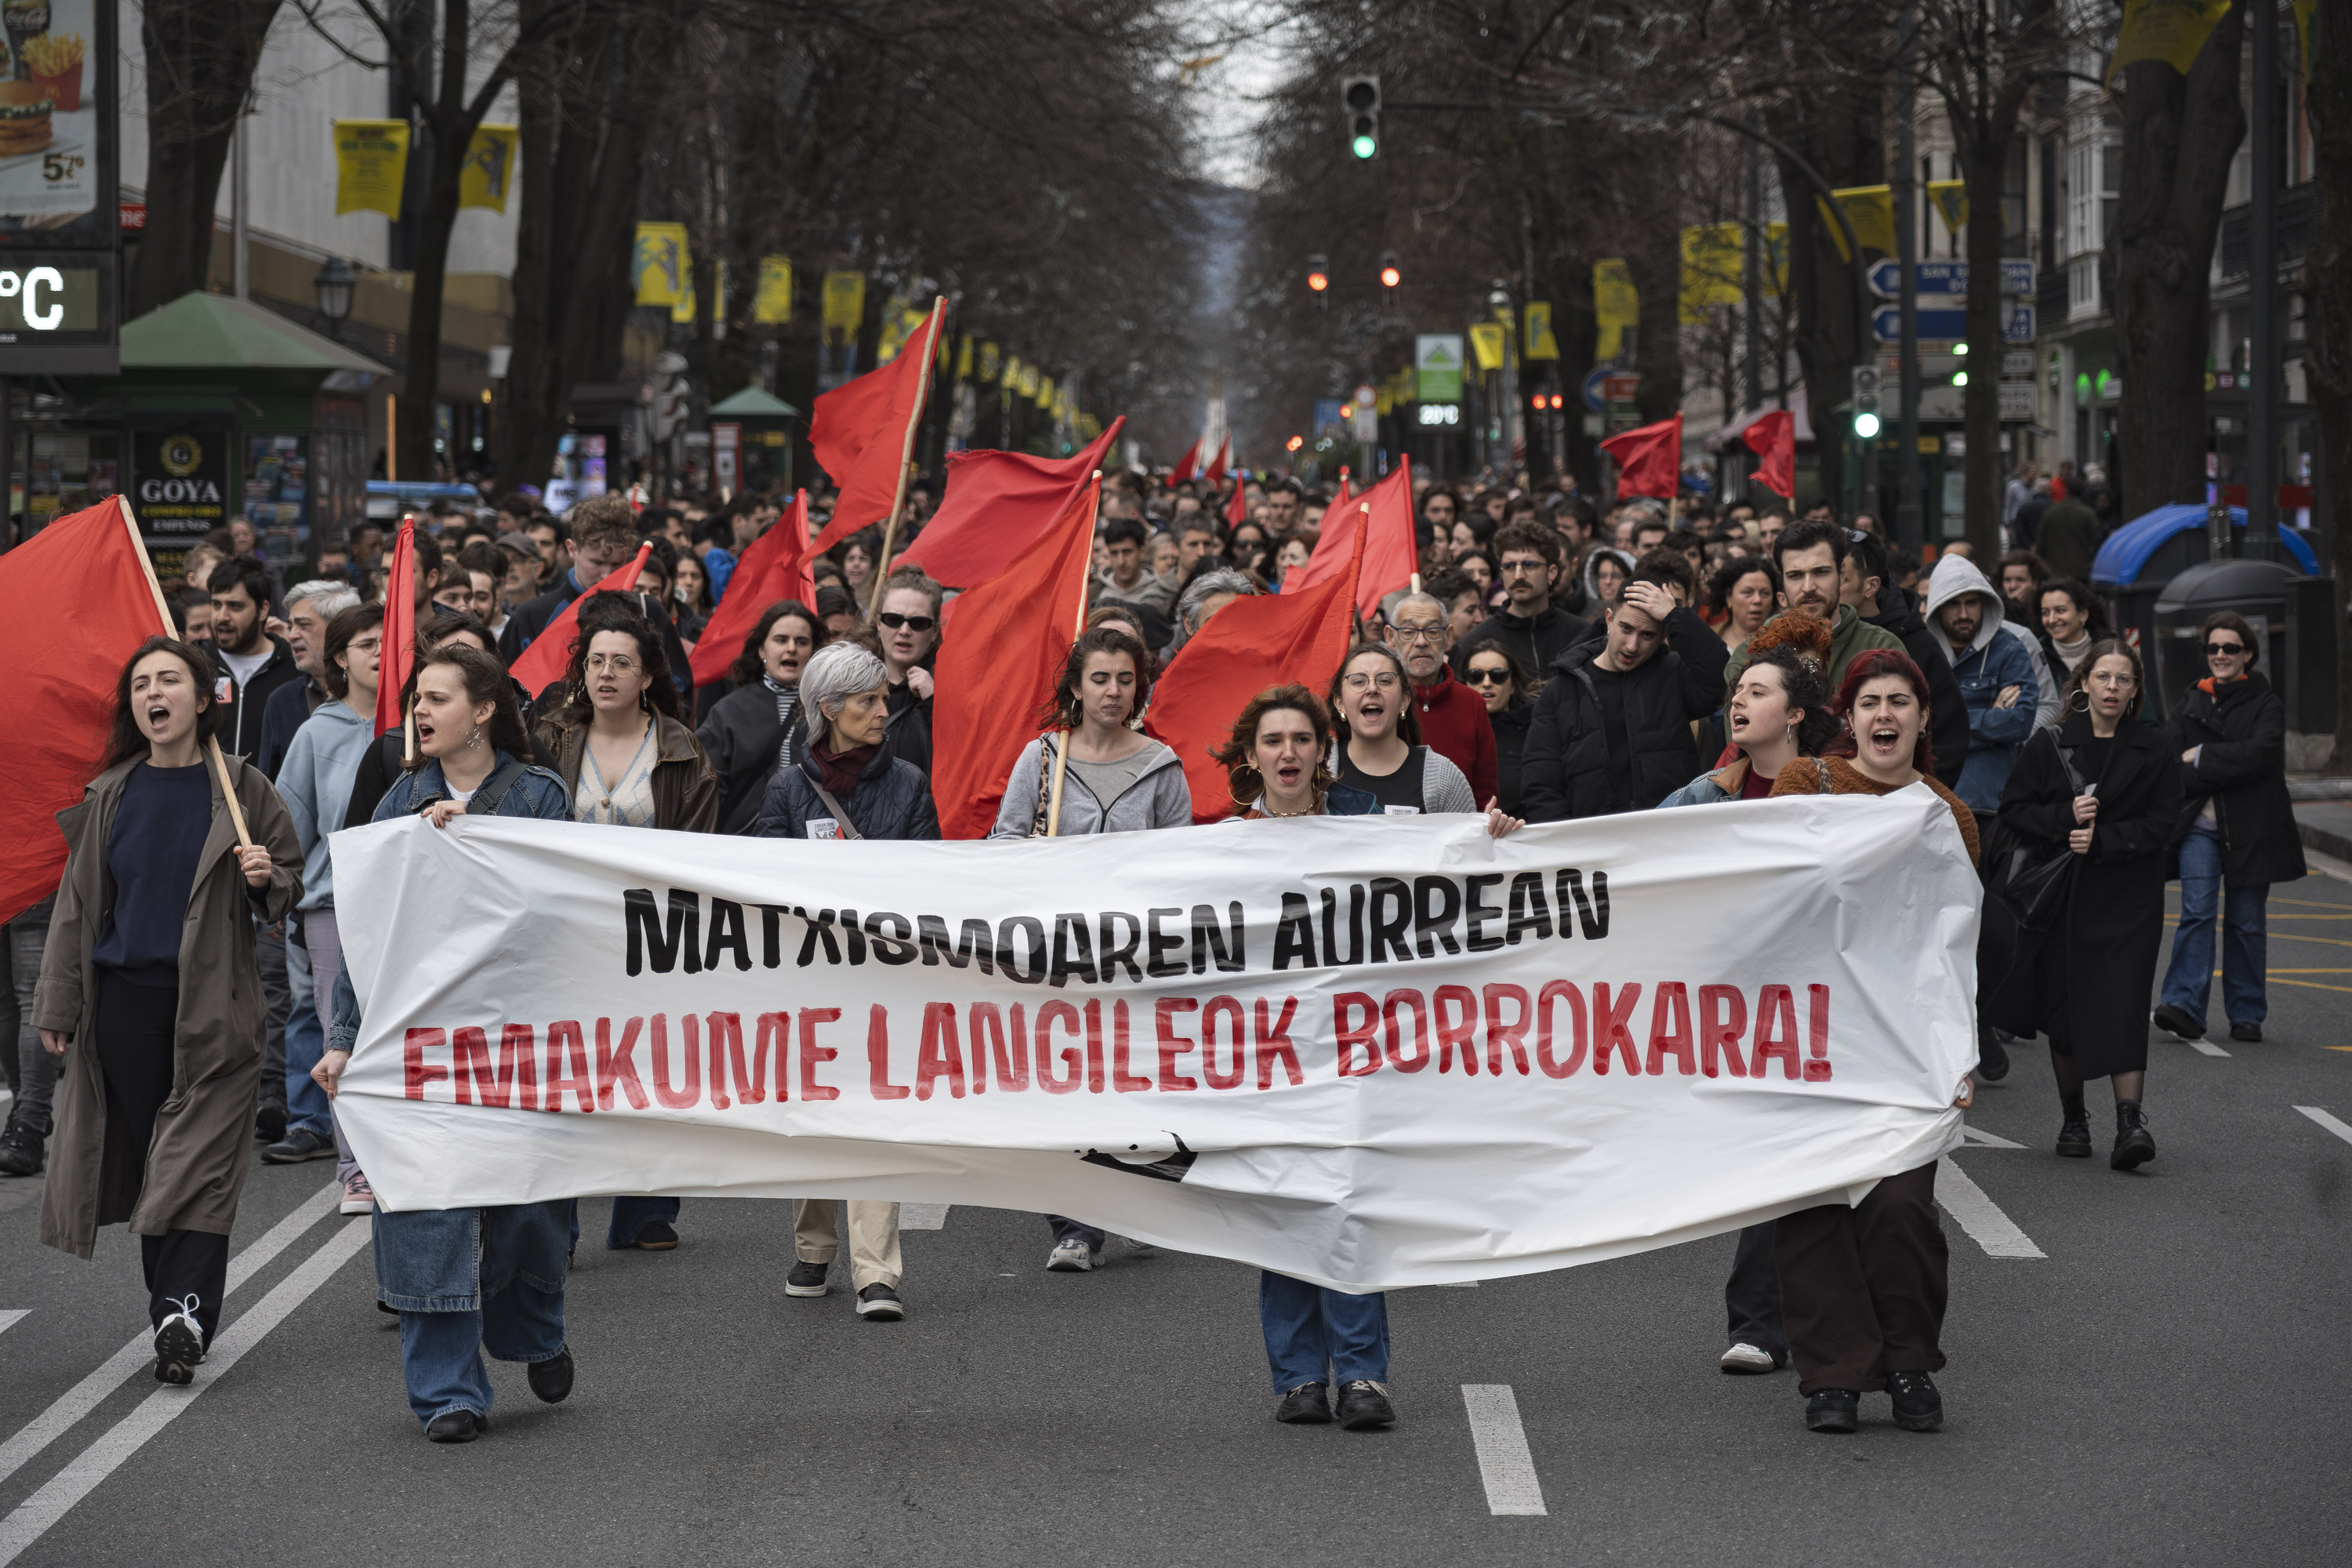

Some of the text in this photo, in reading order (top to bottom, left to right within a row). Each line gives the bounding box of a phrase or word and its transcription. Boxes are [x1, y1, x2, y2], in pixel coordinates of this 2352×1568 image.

[1921, 267, 1951, 279] SAN
[140, 479, 222, 503] GOYA
[141, 505, 223, 518] COMPRO ORO
[152, 517, 212, 532] EMPEÑOS
[623, 868, 1610, 988] MATXISMOAREN AURREAN
[867, 994, 1305, 1101] LANGILEOK
[1334, 978, 1833, 1083] BORROKARA!
